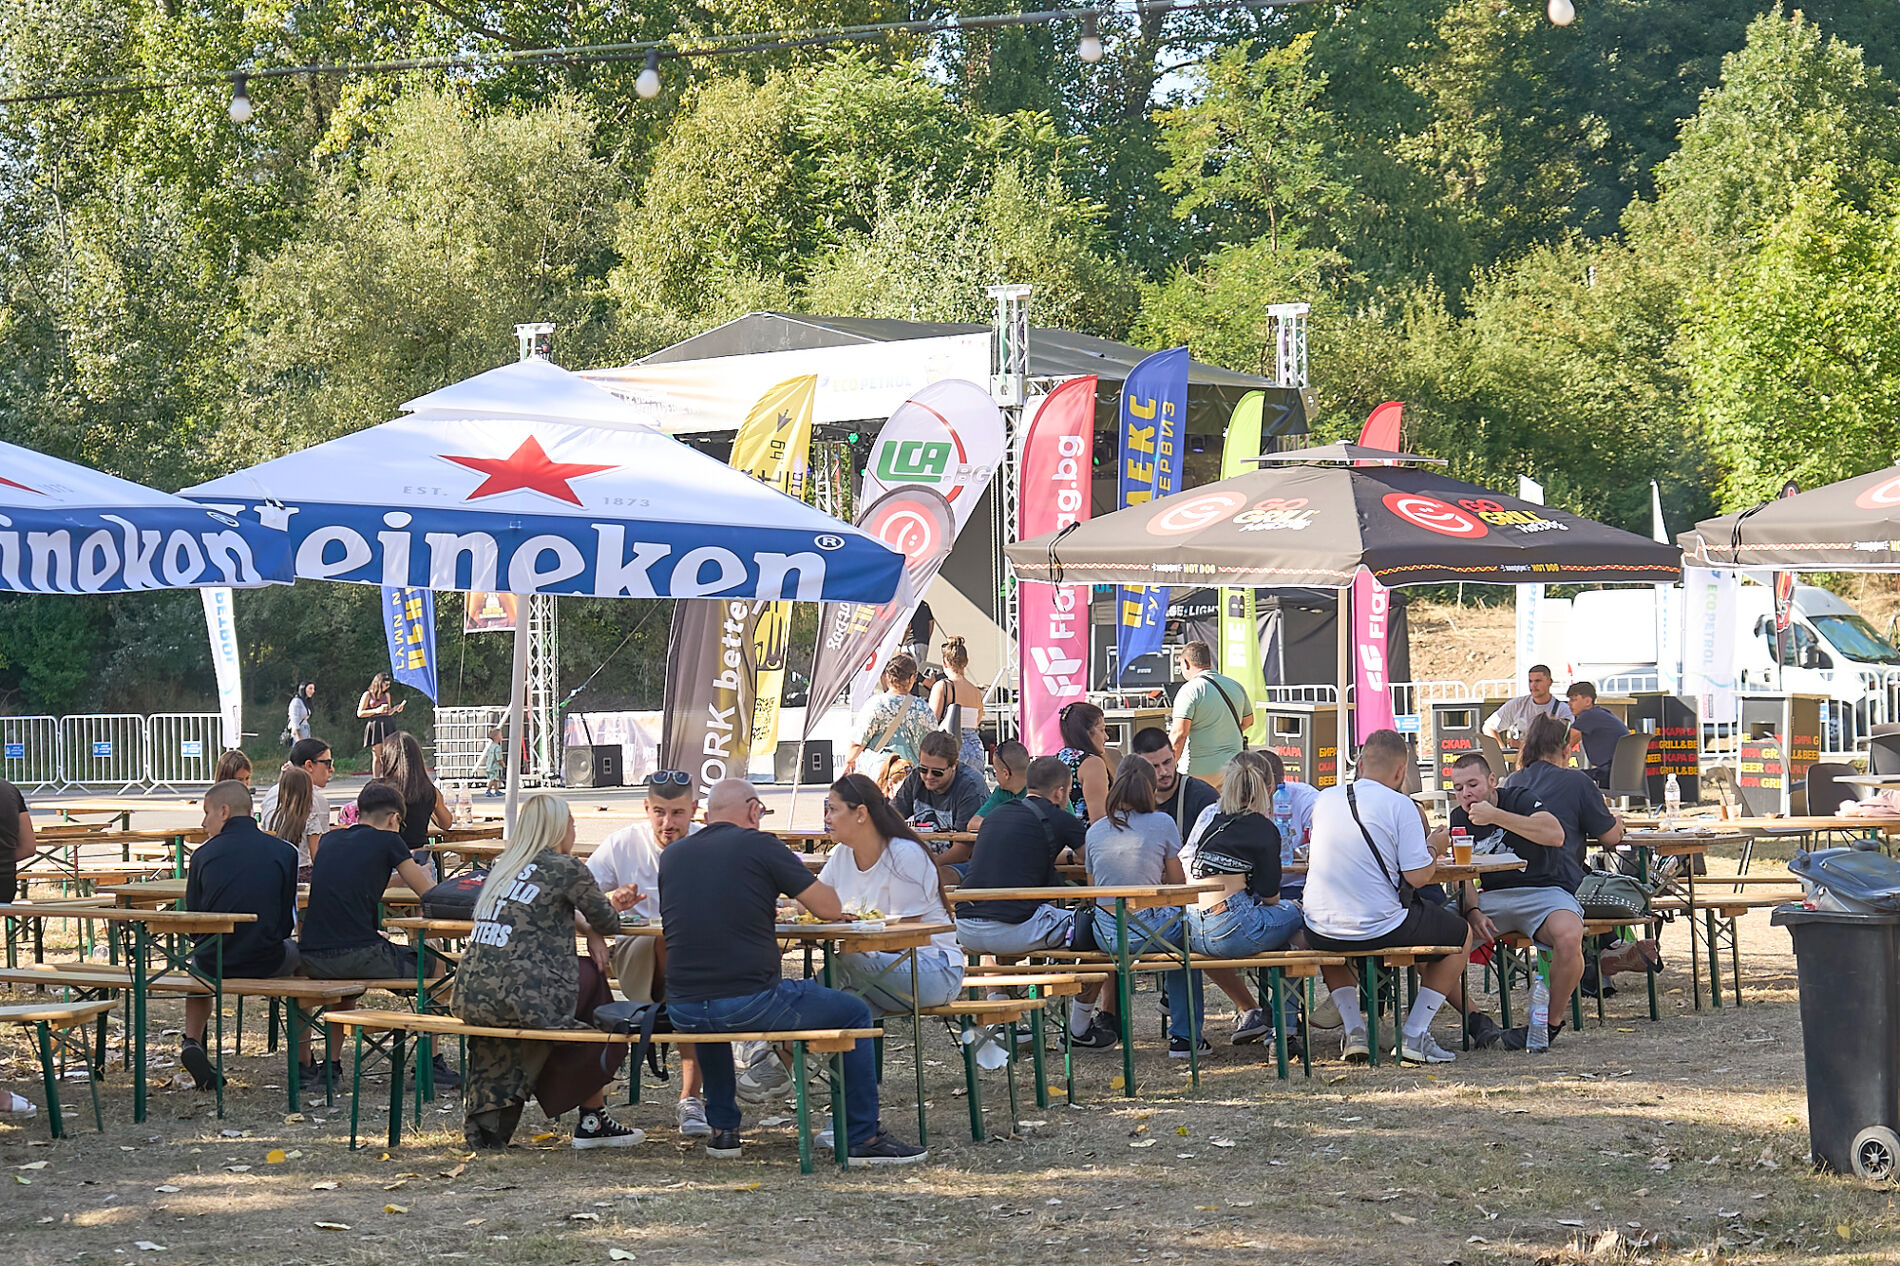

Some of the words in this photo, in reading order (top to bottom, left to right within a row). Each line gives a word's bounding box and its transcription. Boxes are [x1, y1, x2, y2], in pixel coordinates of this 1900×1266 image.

[1157, 401, 1176, 501] ЕРВИЗ
[403, 485, 449, 497] EST.
[603, 496, 651, 508] 1873
[1252, 497, 1309, 512] GO
[1458, 498, 1505, 513] GO
[1478, 510, 1549, 526] GRILL
[1184, 563, 1199, 574] HOT
[1200, 564, 1216, 575] DOG
[826, 602, 851, 651] otDog
[713, 596, 748, 691] bette
[1441, 739, 1472, 750] СКАРА
[1764, 763, 1784, 775] СКА
[1760, 778, 1782, 789] GRI
